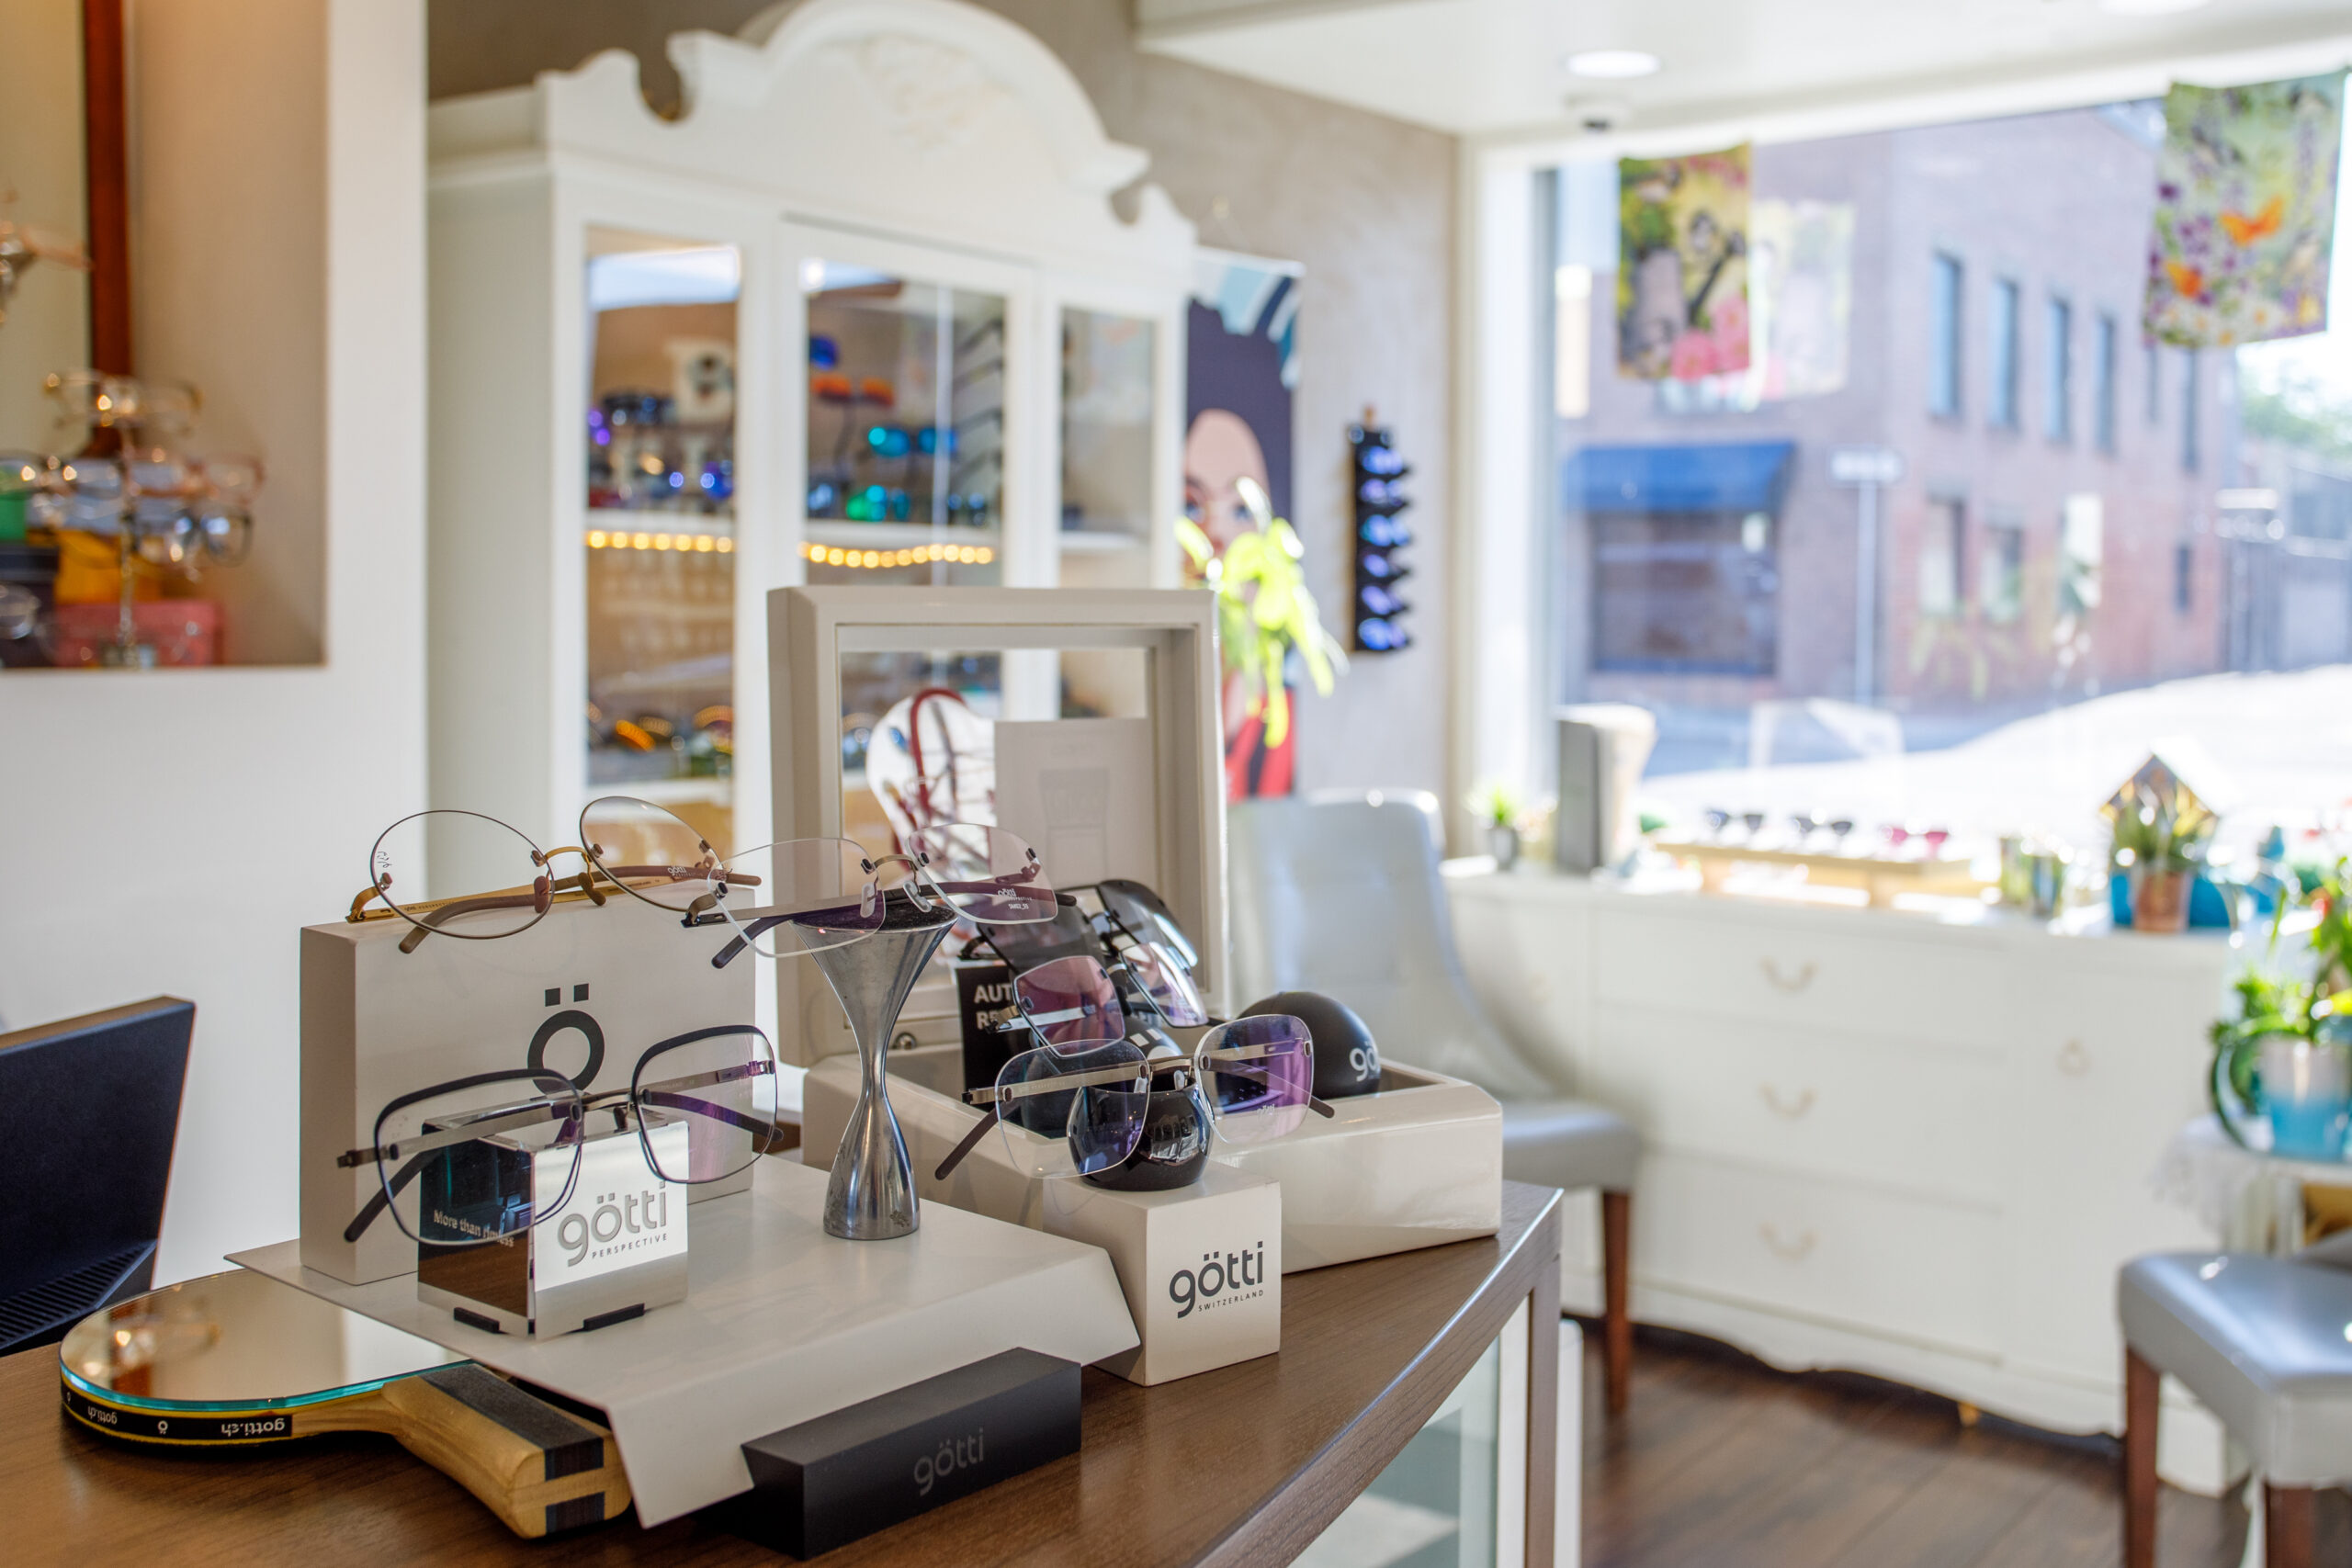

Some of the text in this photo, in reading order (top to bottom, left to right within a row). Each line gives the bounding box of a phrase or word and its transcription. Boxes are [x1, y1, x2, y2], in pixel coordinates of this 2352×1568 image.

[434, 1209, 458, 1230] More
[459, 1218, 481, 1237] than
[557, 1180, 666, 1268] götti
[592, 1233, 667, 1259] PERSPECTIVE
[1169, 1240, 1263, 1319] götti
[1198, 1290, 1263, 1313] SWITZERLAND
[913, 1427, 984, 1497] götti
